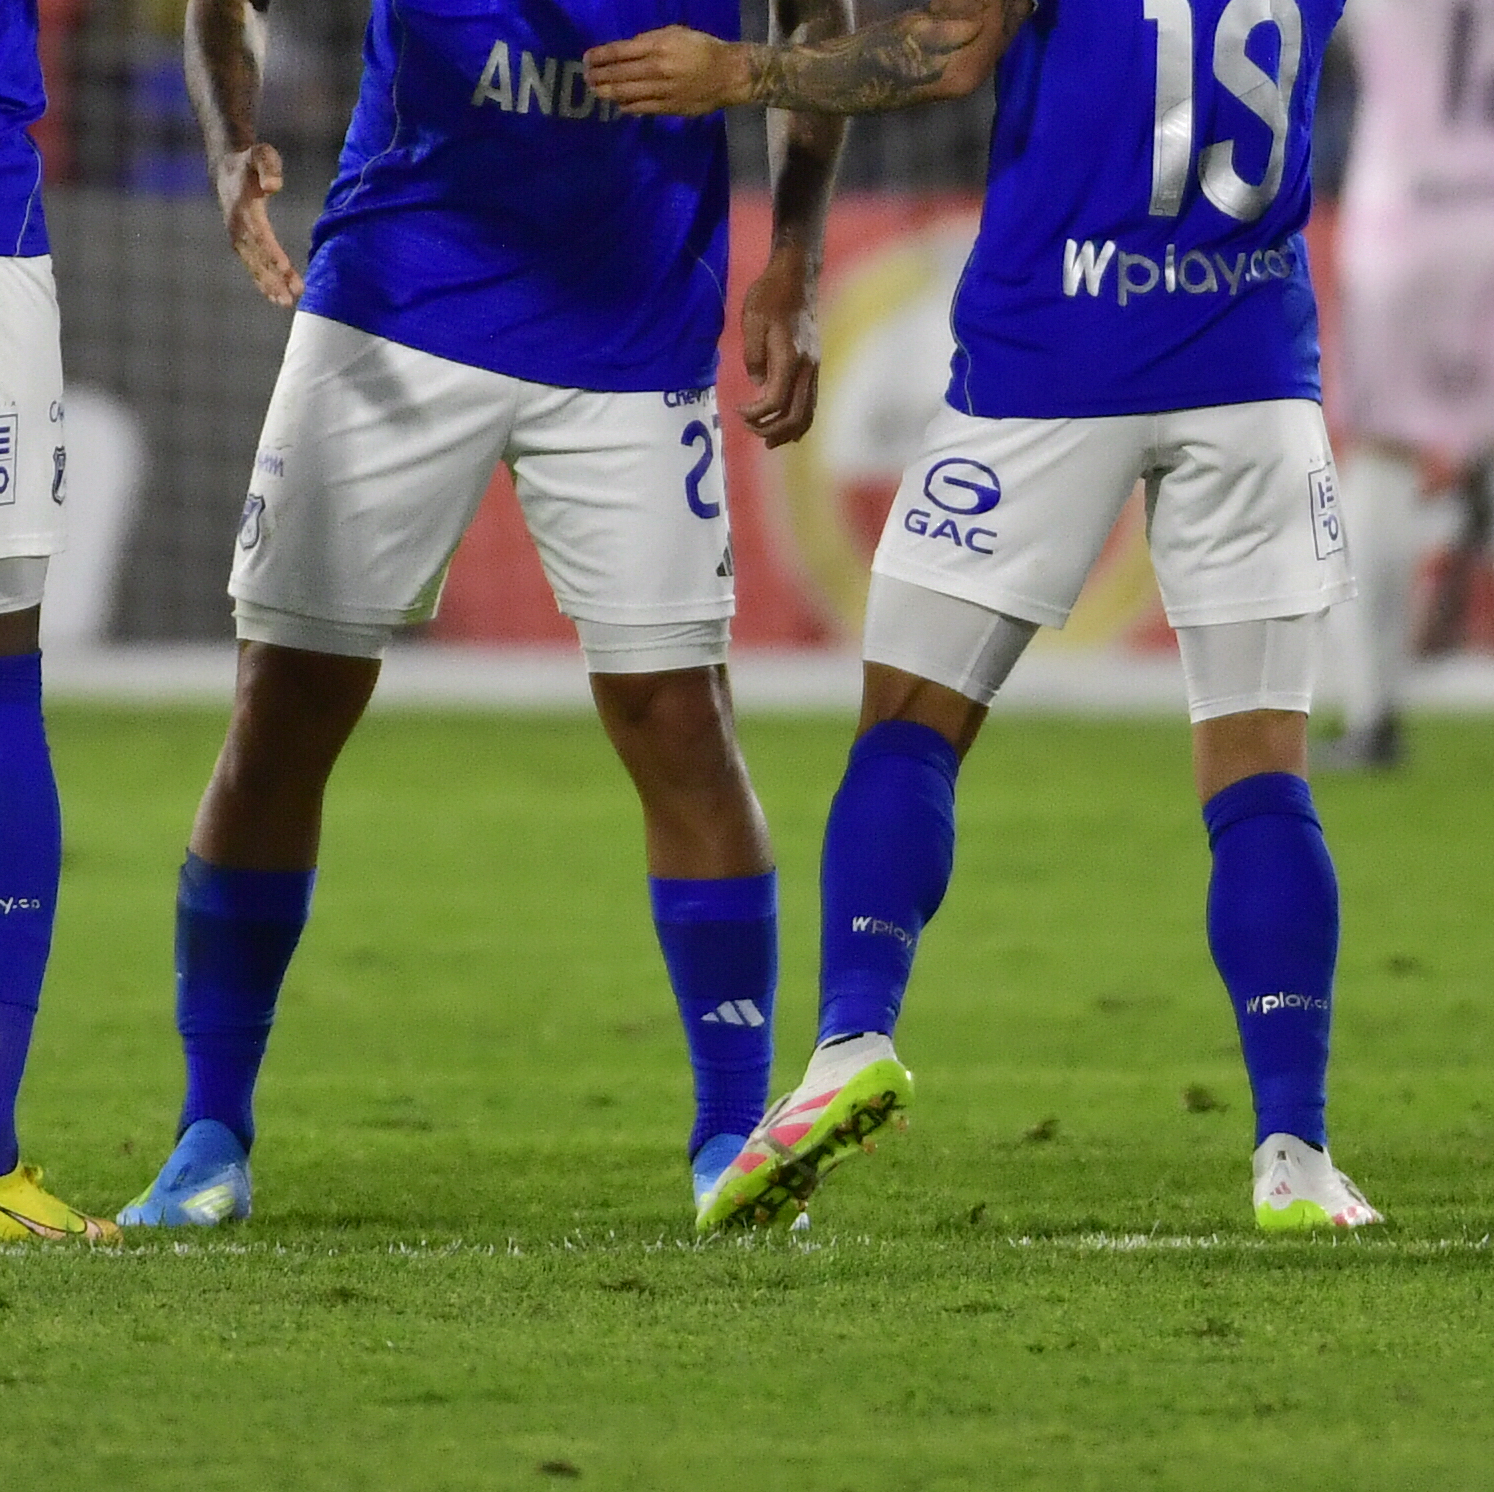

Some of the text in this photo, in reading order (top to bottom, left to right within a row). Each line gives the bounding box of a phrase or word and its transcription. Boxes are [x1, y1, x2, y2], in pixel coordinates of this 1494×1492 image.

[471, 39, 625, 122] AND
[680, 412, 726, 521] 2
[904, 508, 998, 555] GAC
